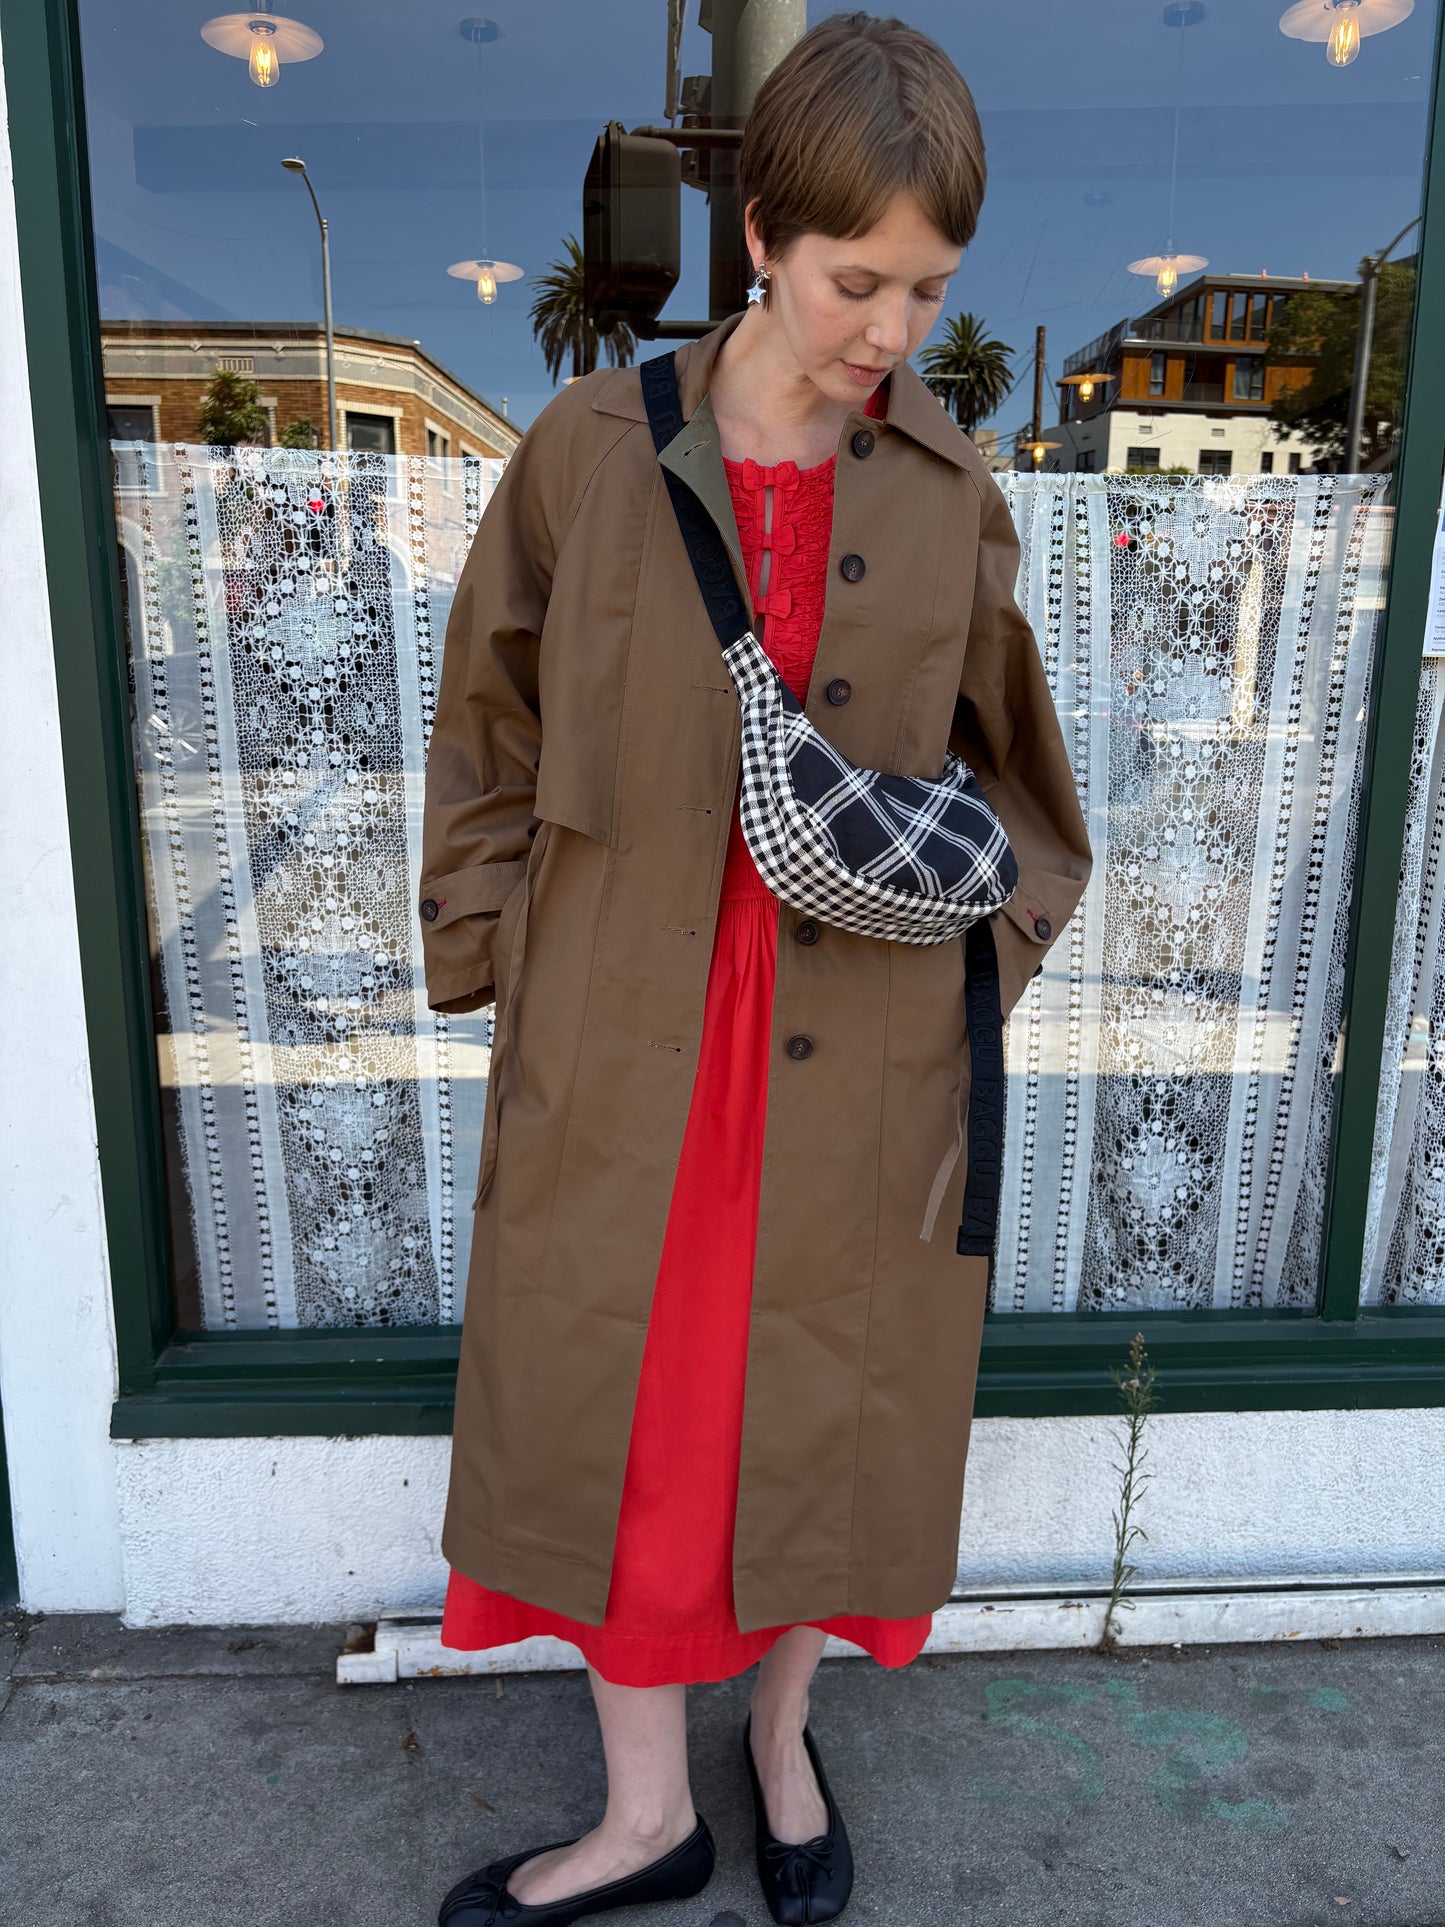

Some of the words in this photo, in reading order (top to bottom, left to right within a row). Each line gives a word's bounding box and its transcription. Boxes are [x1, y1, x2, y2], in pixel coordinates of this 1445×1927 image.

[644, 356, 672, 400] BAG
[970, 971, 1001, 1063] BAGGU
[974, 1078, 1001, 1176] BAGGU
[967, 1195, 996, 1236] BA
